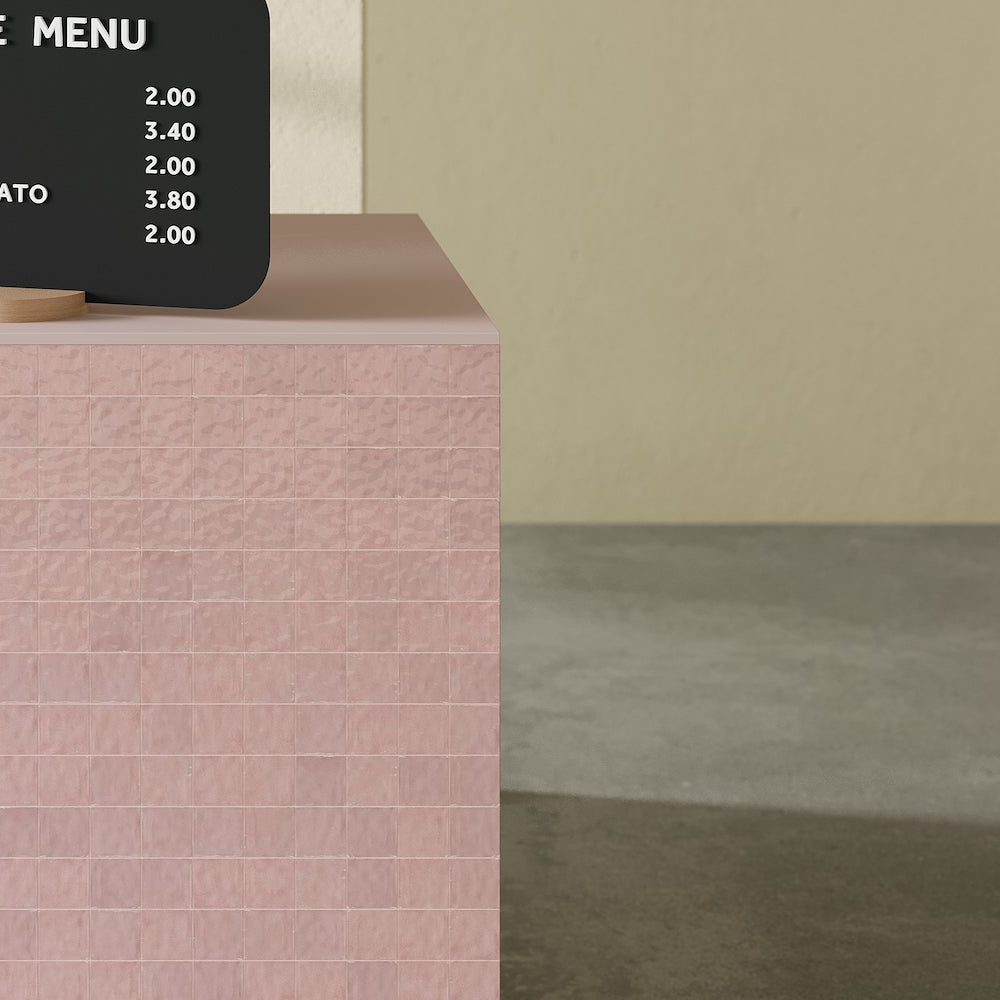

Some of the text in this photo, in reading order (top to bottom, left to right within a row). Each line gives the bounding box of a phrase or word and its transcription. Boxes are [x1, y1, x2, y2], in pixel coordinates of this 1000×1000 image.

[33, 15, 147, 51] MENU
[145, 86, 196, 107] 2.00
[144, 120, 196, 142] 3.40
[144, 155, 196, 176] 2.00
[144, 189, 196, 211] 3.80
[144, 223, 196, 245] 2.00
